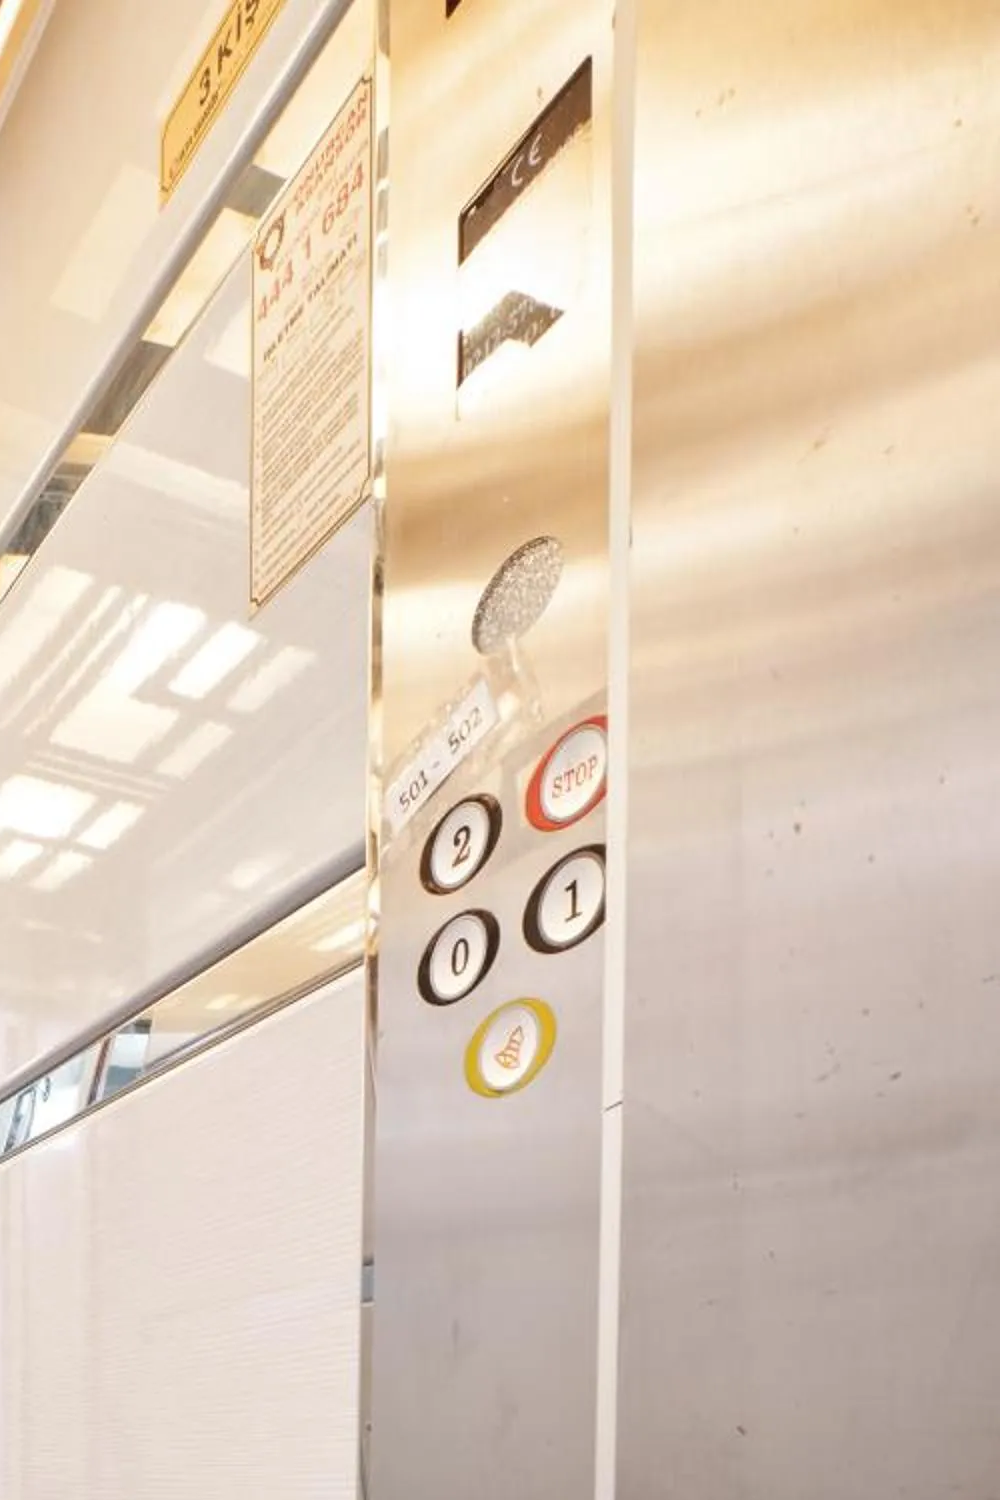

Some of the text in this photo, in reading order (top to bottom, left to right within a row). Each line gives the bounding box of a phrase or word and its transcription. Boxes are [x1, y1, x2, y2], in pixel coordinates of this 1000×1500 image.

[511, 132, 542, 187] CE
[400, 769, 429, 814] 501
[448, 707, 483, 755] 502
[552, 756, 599, 799] STOP
[452, 825, 472, 868] 2
[564, 879, 582, 923] 1
[451, 938, 469, 976] 0
